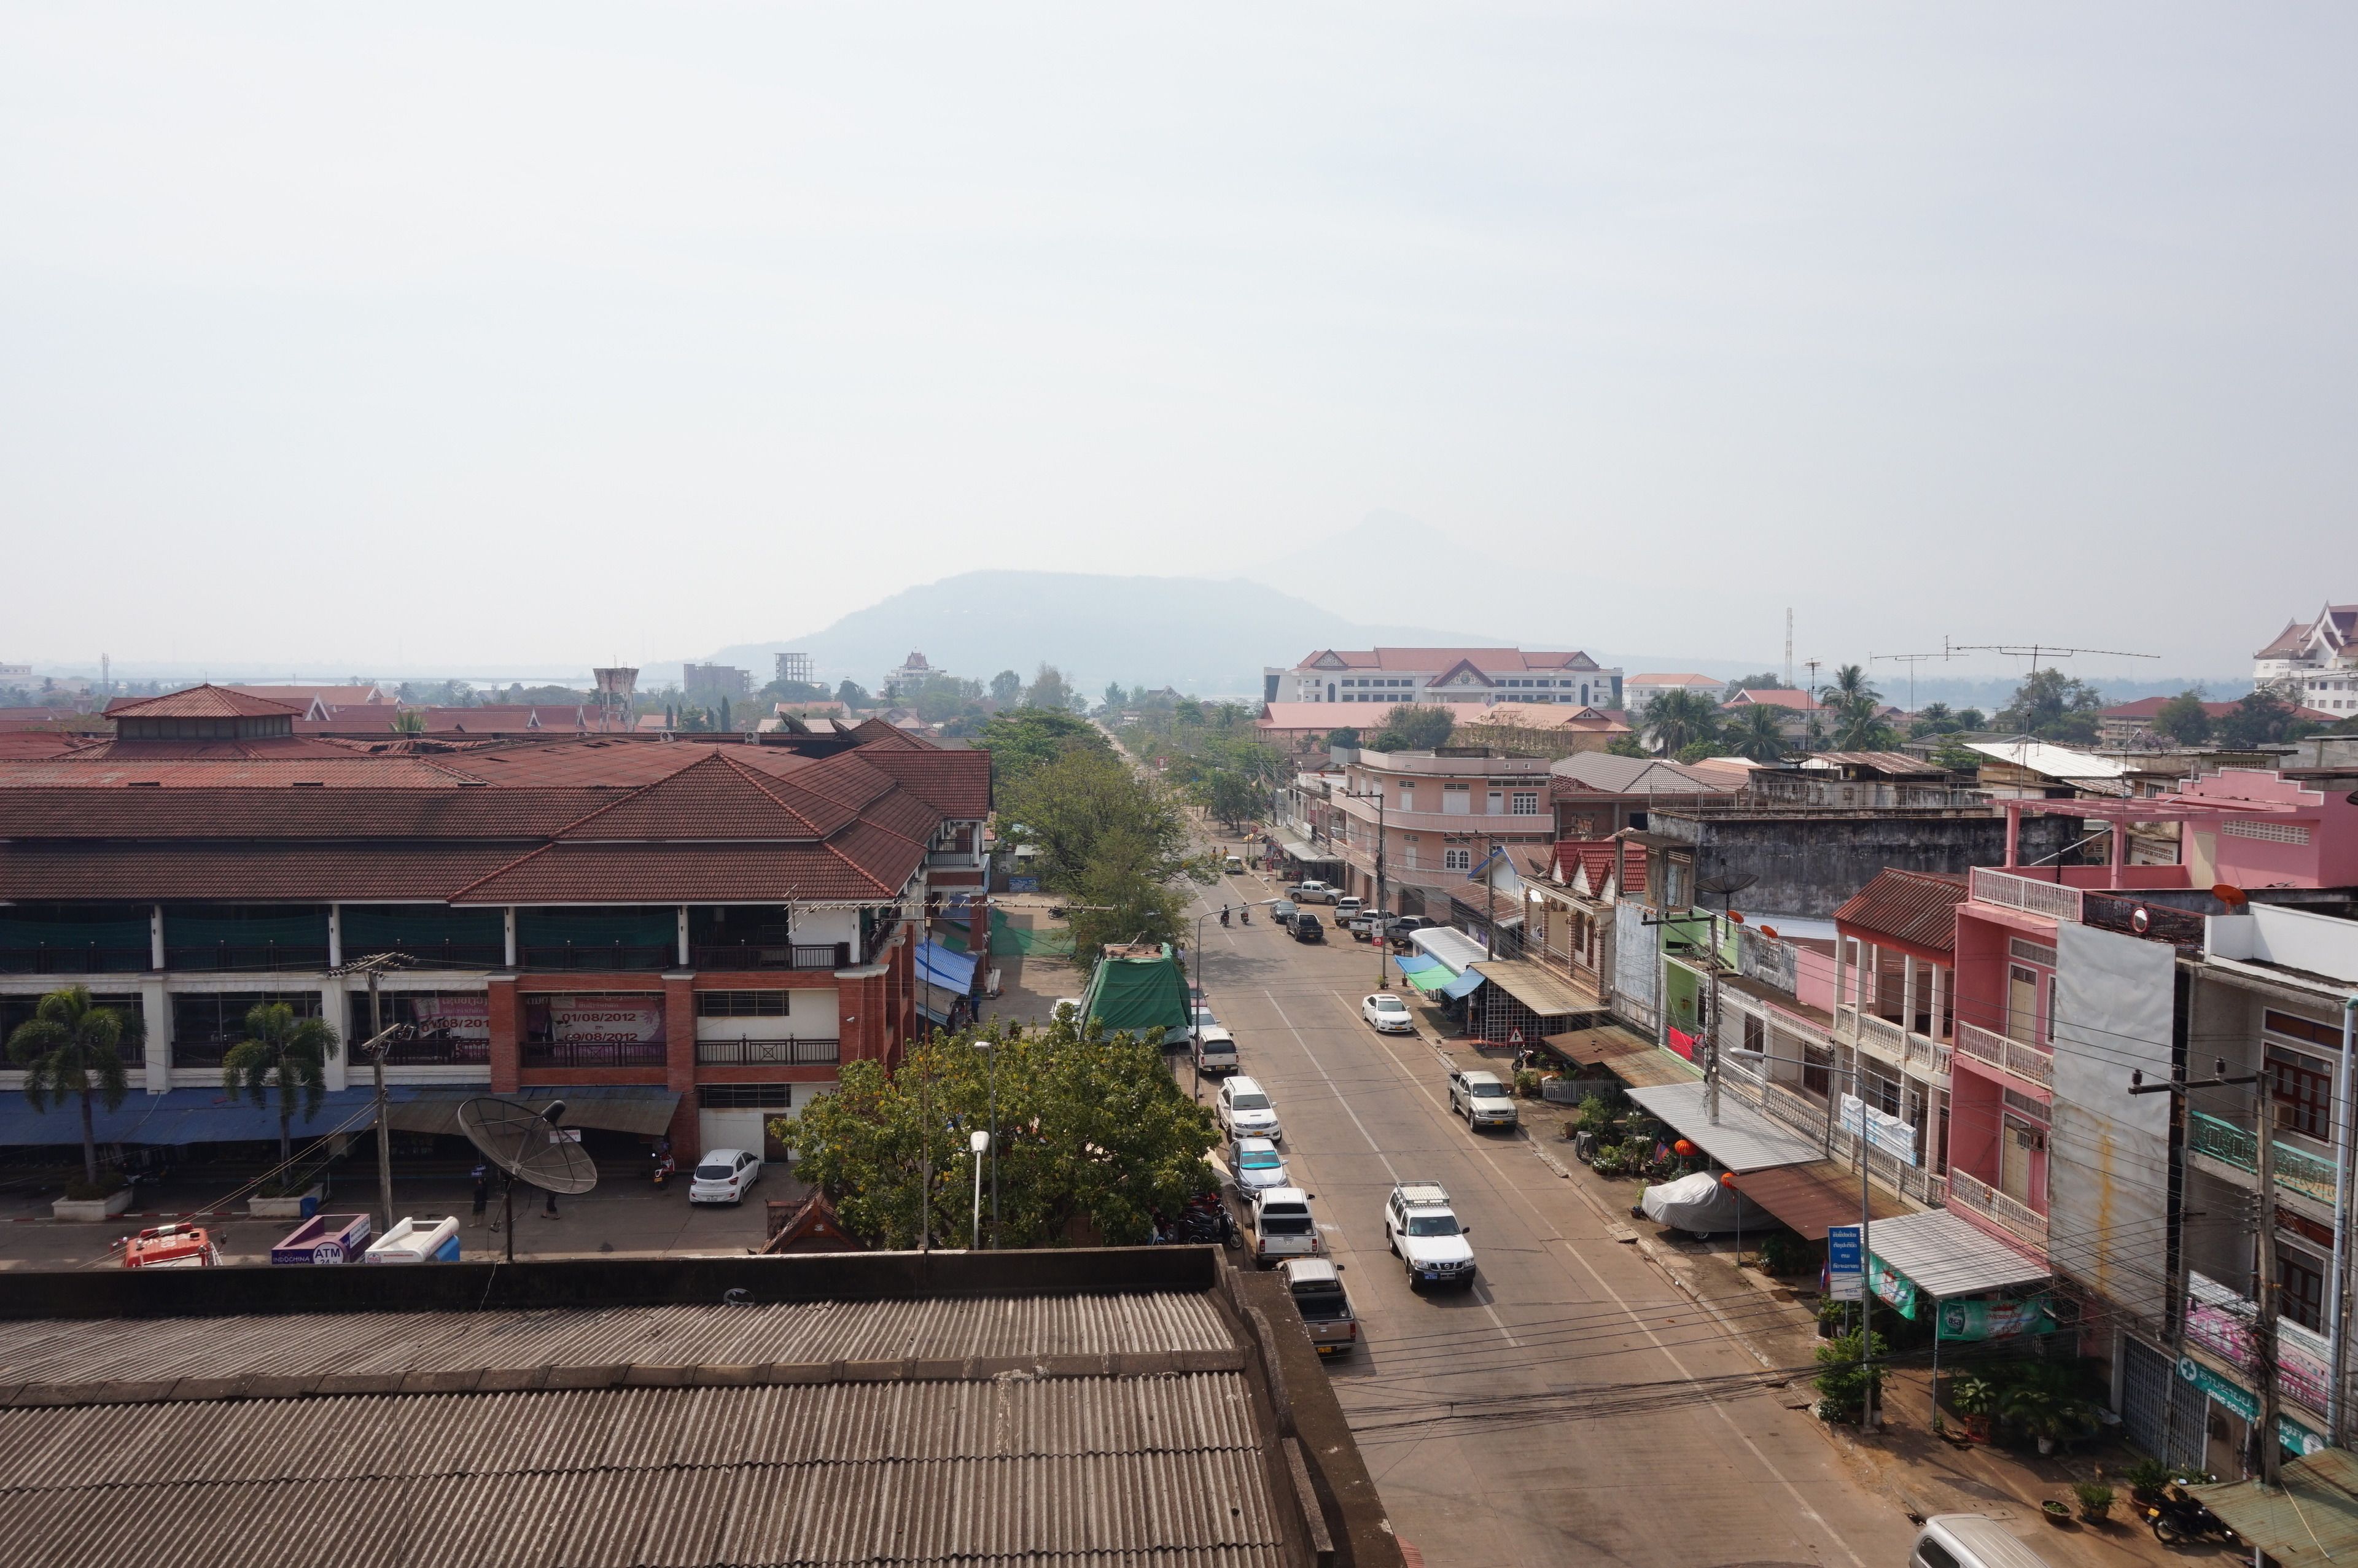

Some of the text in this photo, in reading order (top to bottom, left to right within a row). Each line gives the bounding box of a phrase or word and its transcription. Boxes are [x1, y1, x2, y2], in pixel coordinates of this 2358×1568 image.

[561, 1013, 636, 1022] 01/08/2012
[421, 1019, 489, 1033] 01/08/201
[315, 1249, 340, 1258] ATM
[2207, 1388, 2226, 1405] SENG
